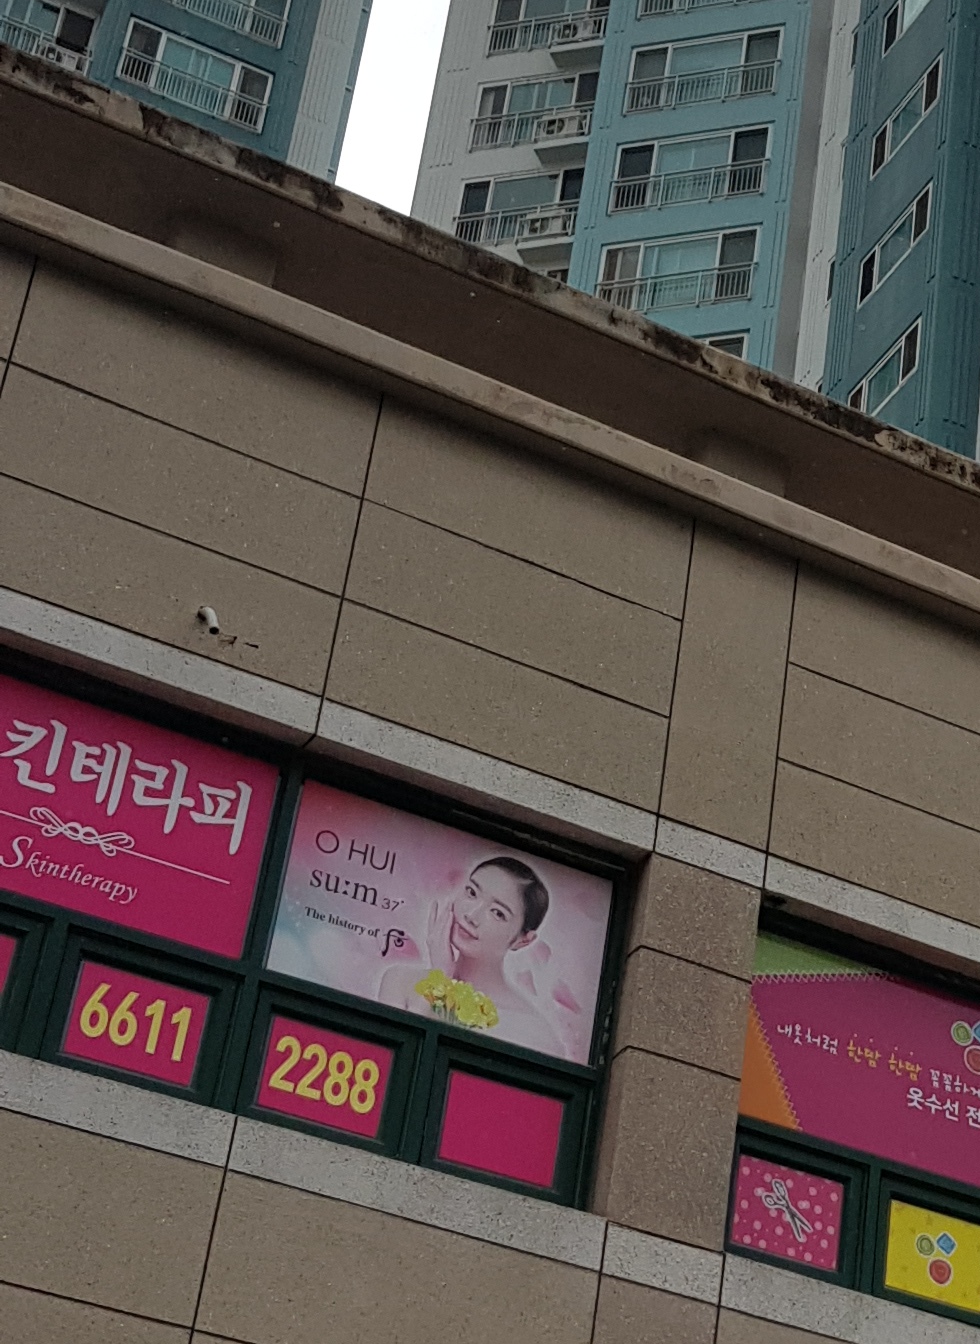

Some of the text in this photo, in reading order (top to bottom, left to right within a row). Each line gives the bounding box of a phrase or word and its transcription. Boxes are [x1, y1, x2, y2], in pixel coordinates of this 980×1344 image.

[0, 719, 252, 856] 킨테라피
[0, 835, 138, 904] Skintherapy
[315, 829, 396, 875] O HUI
[304, 906, 326, 922] The
[328, 913, 367, 936] history
[367, 928, 381, 938] of
[79, 982, 193, 1062] 6611
[777, 1023, 839, 1055] 내옷처럼
[847, 1040, 881, 1068] 한땀
[888, 1052, 922, 1082] 한땀
[268, 1035, 380, 1114] 2288
[906, 1087, 960, 1122] 옷수선
